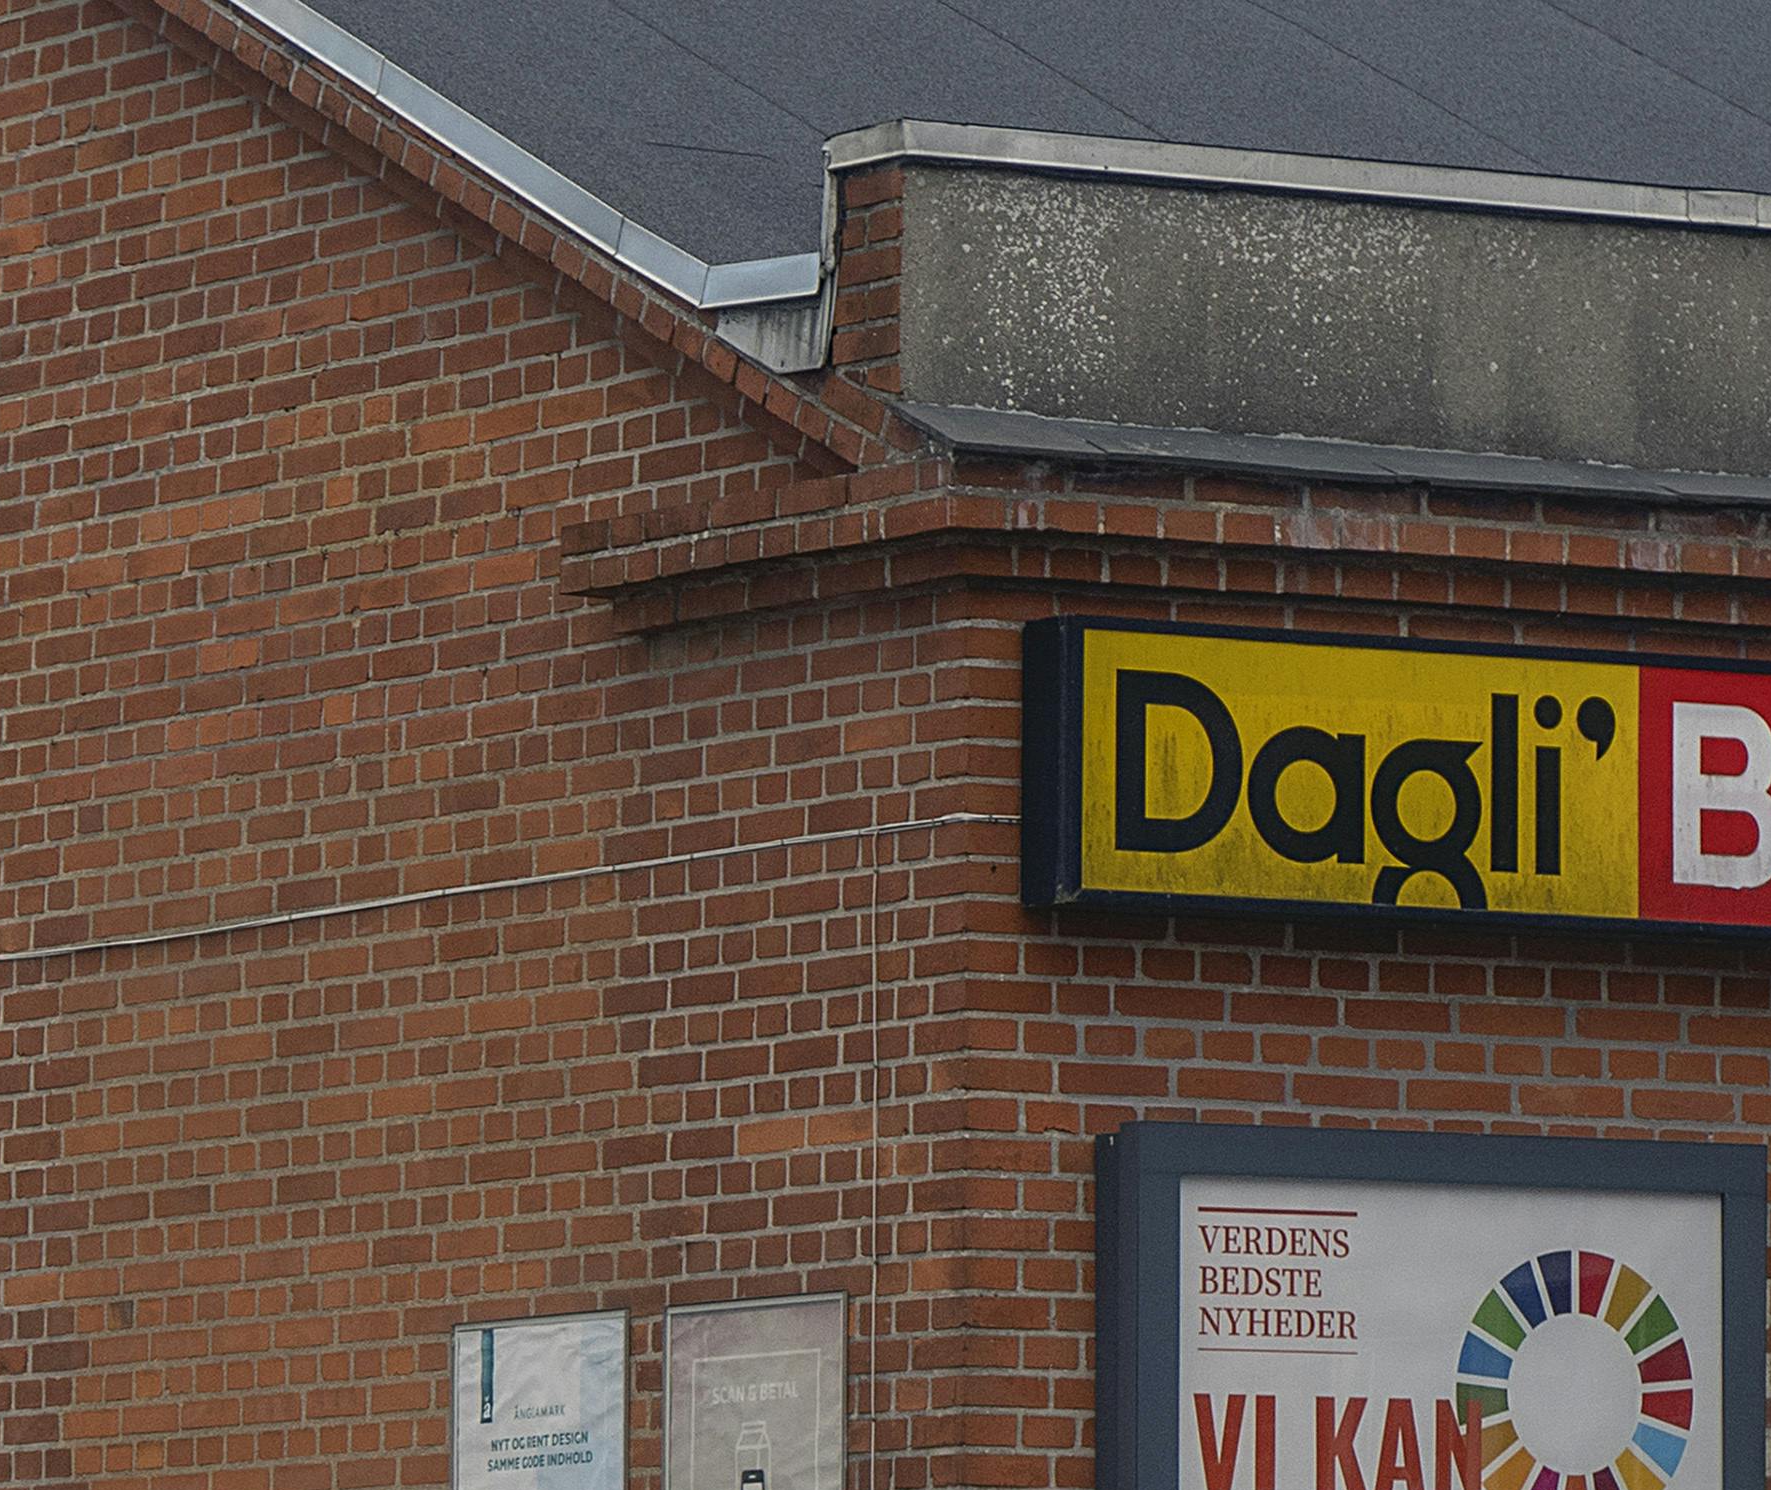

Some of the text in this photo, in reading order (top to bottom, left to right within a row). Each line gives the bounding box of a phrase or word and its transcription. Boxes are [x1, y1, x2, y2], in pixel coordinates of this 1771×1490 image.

[1198, 1223, 1351, 1259] VERDENS
[1198, 1265, 1323, 1299] BEDSTE
[1197, 1306, 1358, 1340] NYHEDER
[712, 1385, 746, 1405] SCAN
[759, 1381, 799, 1401] BETAL
[491, 1430, 590, 1452] NYT OG RENT DESIGN
[487, 1450, 594, 1472] SAMME GODE INDHOLD
